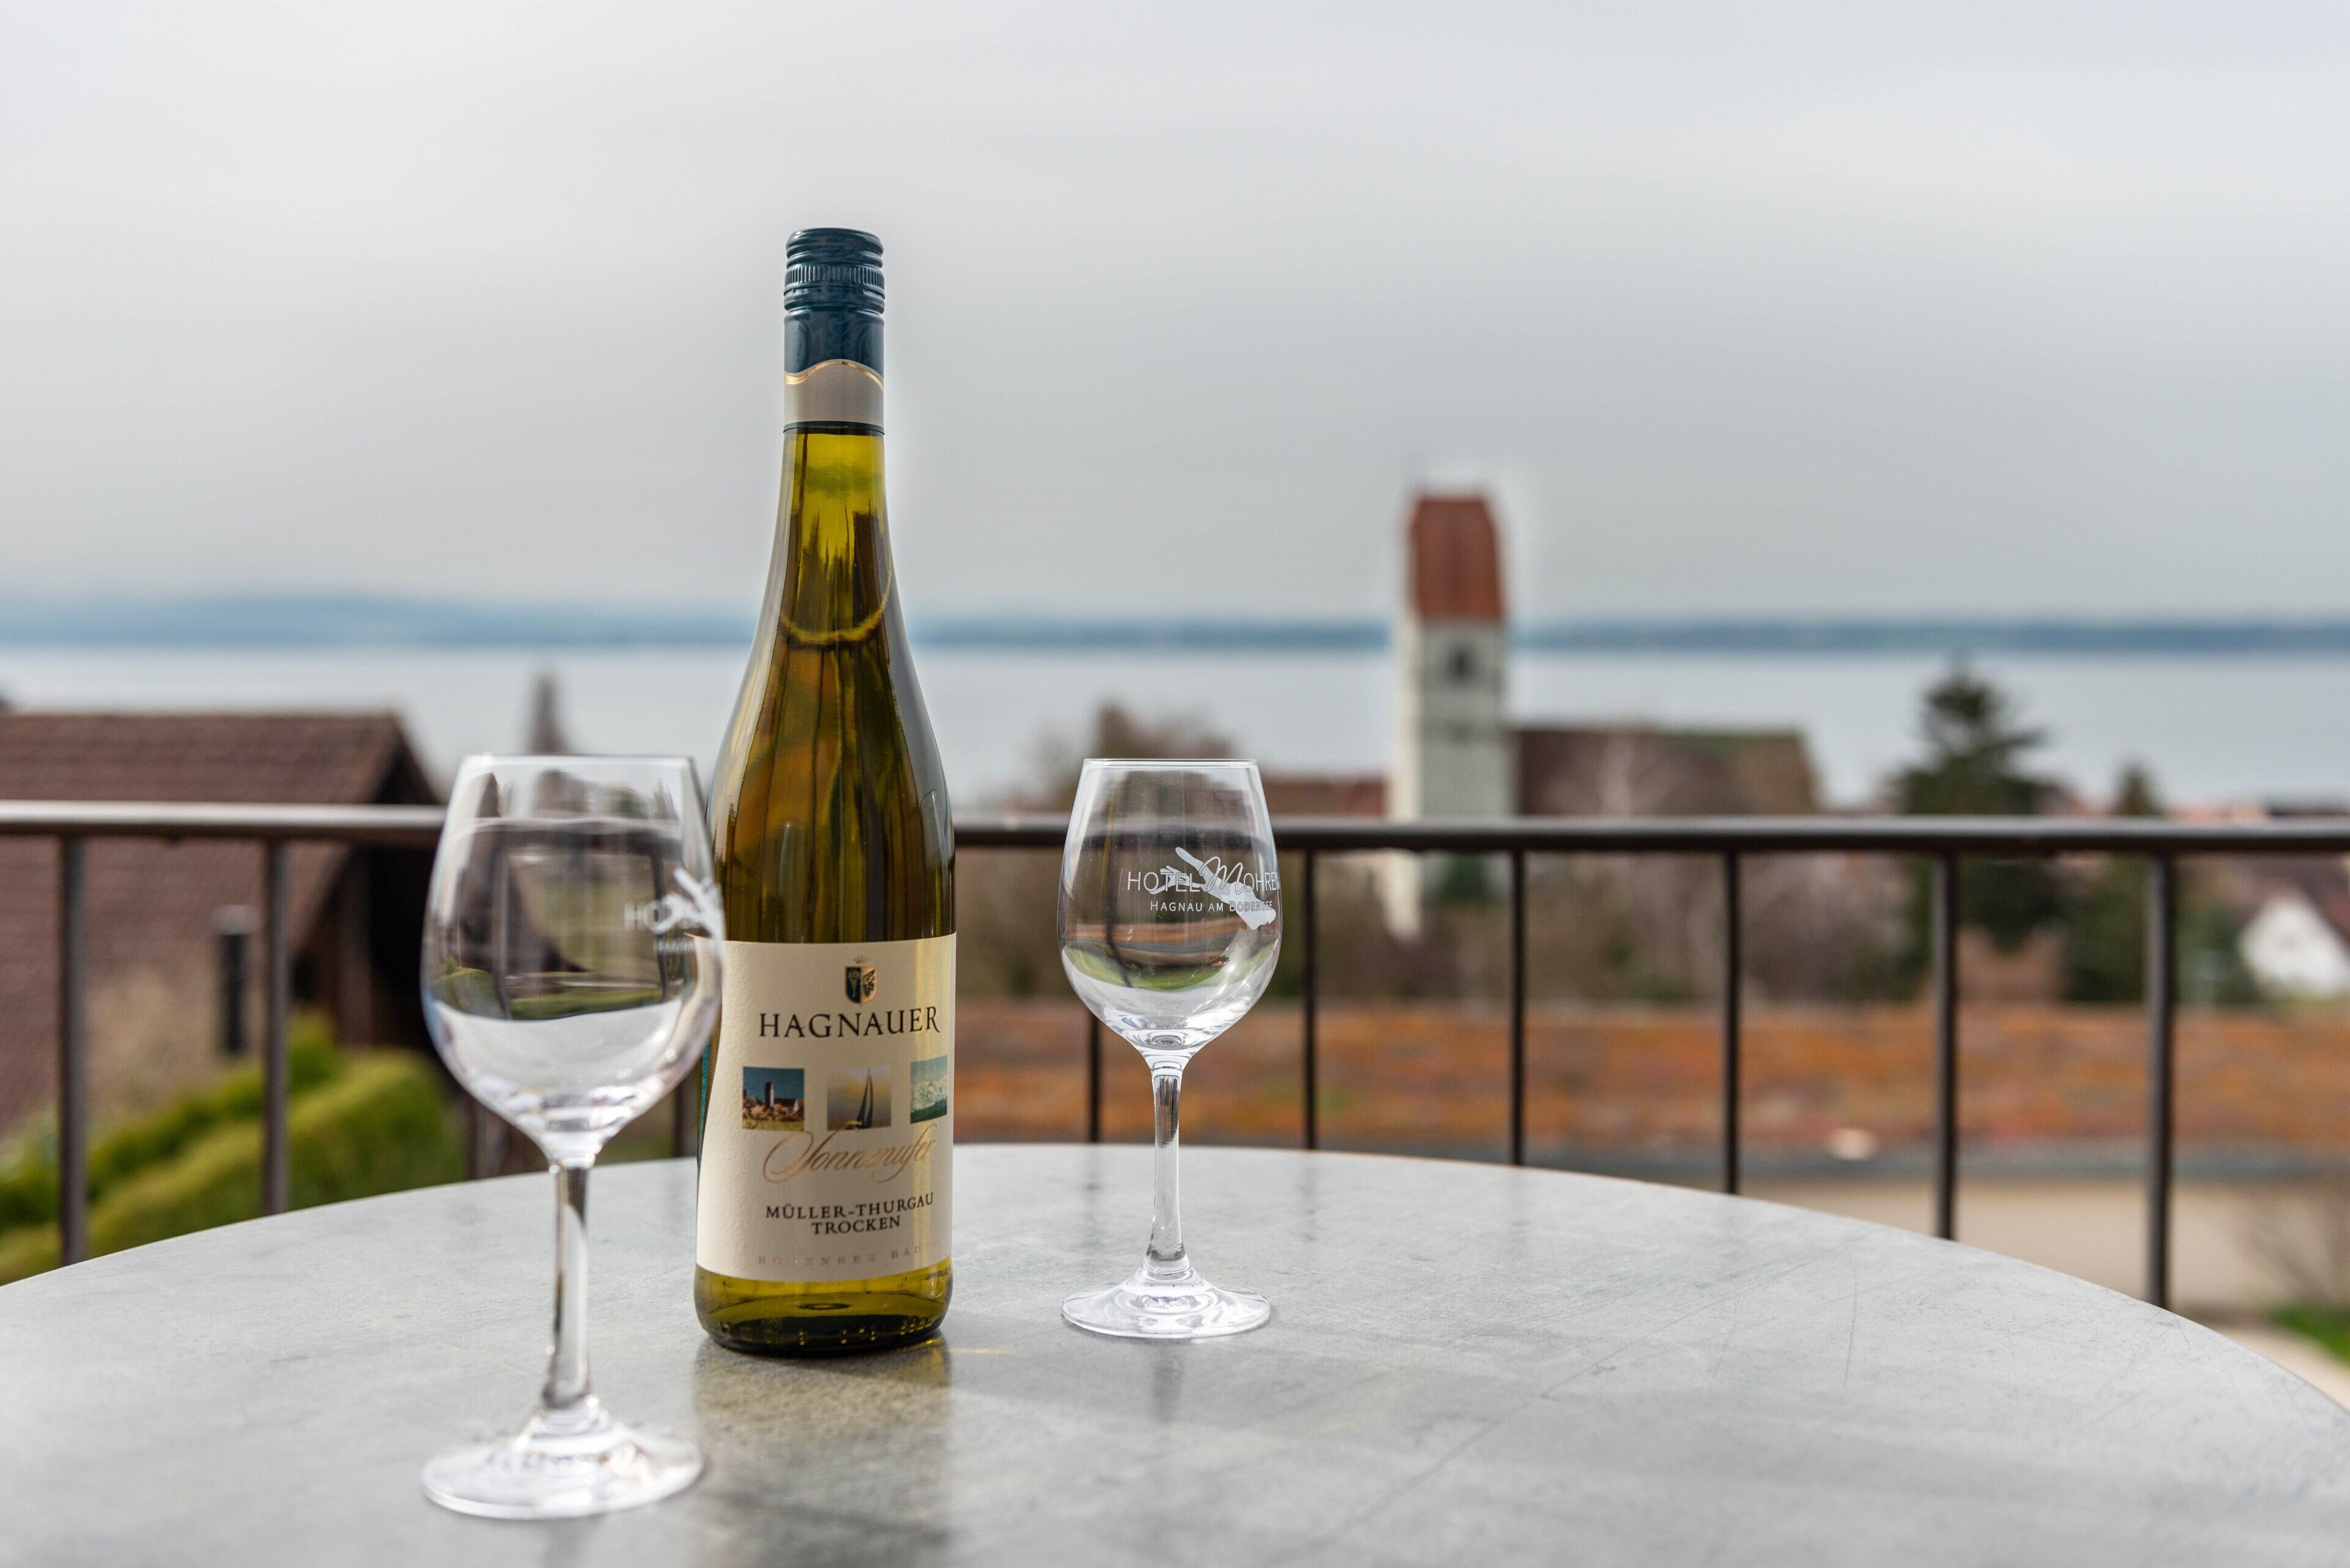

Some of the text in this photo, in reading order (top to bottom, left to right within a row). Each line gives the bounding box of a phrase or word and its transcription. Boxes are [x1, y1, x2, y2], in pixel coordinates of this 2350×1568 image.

[1127, 856, 1280, 895] HOTEL MOHREN
[1149, 900, 1274, 913] HAGNAU AM BODENSEE
[759, 1006, 941, 1039] HAGNAUER
[762, 1122, 938, 1184] Sonnenufer
[765, 1192, 934, 1220] MÜLLER-THURGAU
[811, 1215, 901, 1235] TROCKEN
